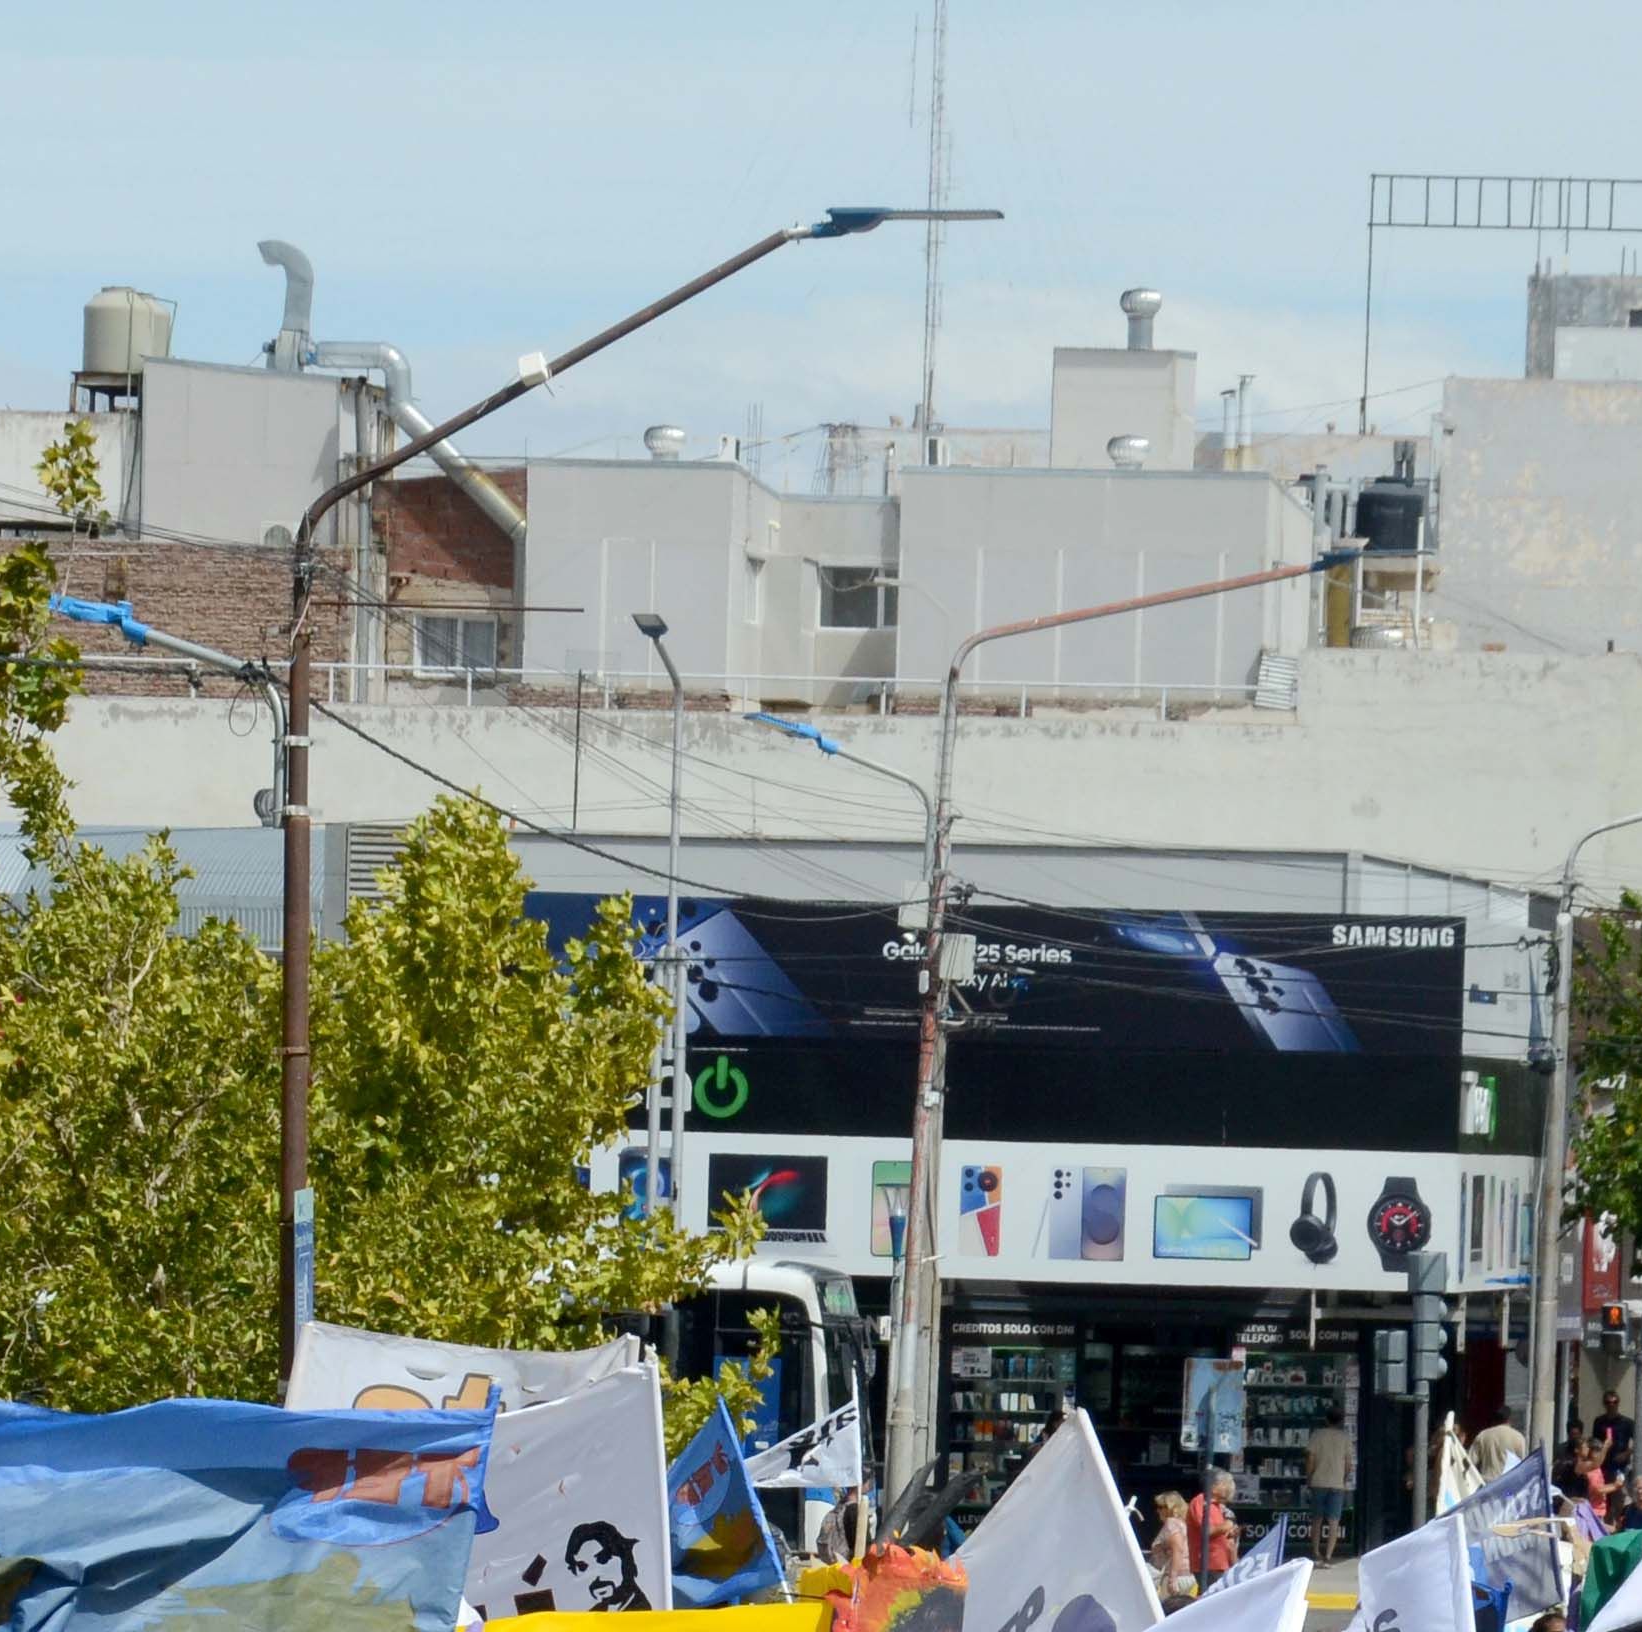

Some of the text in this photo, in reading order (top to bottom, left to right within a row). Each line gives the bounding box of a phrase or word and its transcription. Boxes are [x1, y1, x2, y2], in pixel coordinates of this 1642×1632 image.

[1332, 924, 1455, 948] SAMSUNG
[1005, 944, 1072, 963] Series
[952, 1323, 1002, 1334] CREDITOS
[1003, 1323, 1030, 1334] SOLO
[1032, 1325, 1055, 1335] CON
